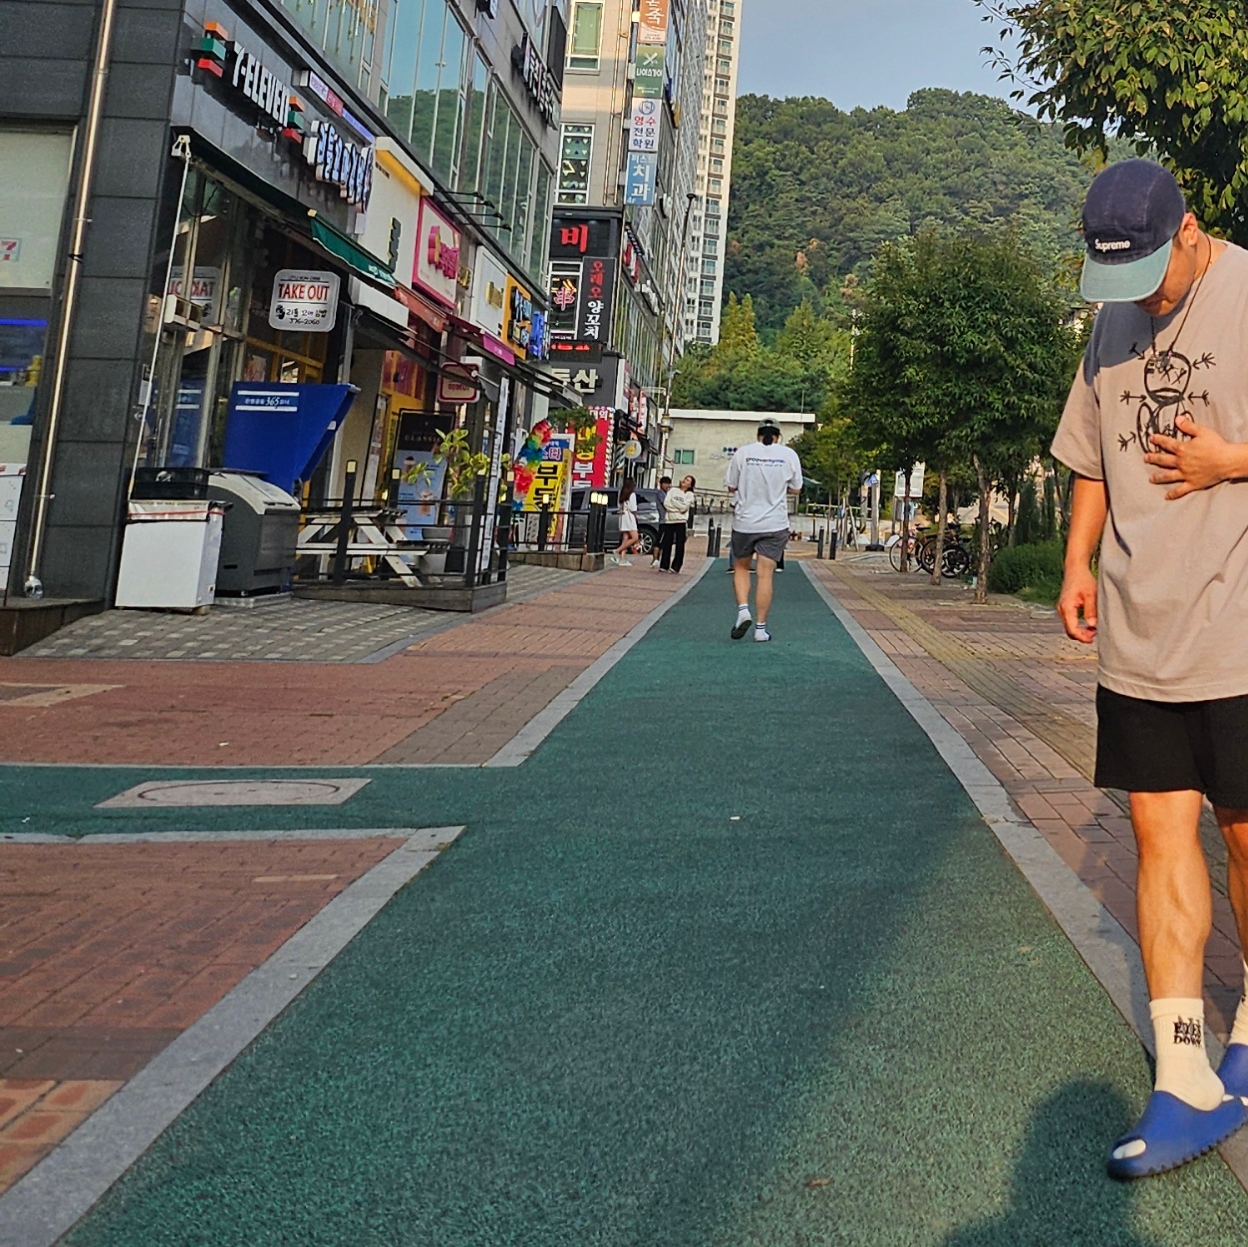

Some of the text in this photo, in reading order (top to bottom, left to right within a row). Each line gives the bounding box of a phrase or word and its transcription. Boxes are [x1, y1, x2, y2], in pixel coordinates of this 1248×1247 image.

[634, 116, 657, 126] 영수
[633, 127, 655, 137] 전문
[632, 138, 655, 149] 학원
[631, 164, 651, 202] 치과
[559, 223, 588, 253] 비
[1094, 237, 1132, 254] Supreme
[278, 283, 330, 301] TAKE OUT
[583, 300, 605, 340] 양꼬치
